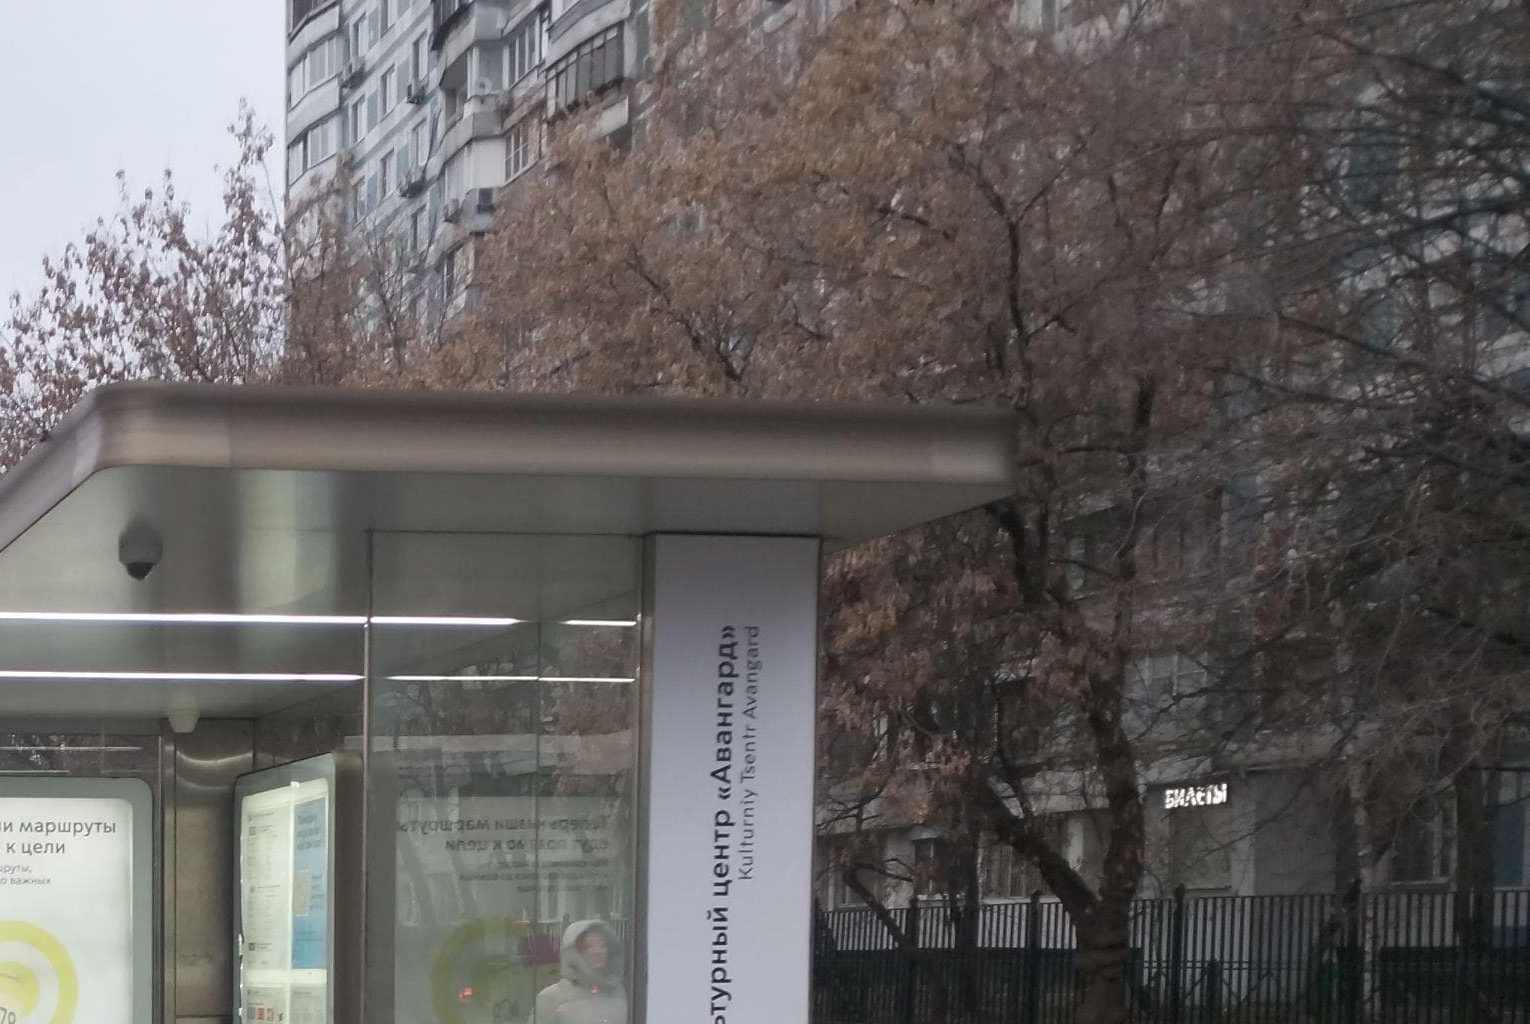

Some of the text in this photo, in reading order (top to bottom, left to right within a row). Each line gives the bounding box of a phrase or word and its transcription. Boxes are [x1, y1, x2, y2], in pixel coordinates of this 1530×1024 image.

[710, 625, 740, 800] «Авангард»
[738, 625, 763, 880] Kulturniy Tsentr Avangard
[6, 842, 16, 853] к
[22, 841, 66, 856] цели
[19, 821, 117, 837] маршруты
[713, 809, 735, 897] центр
[10, 877, 51, 885] важных
